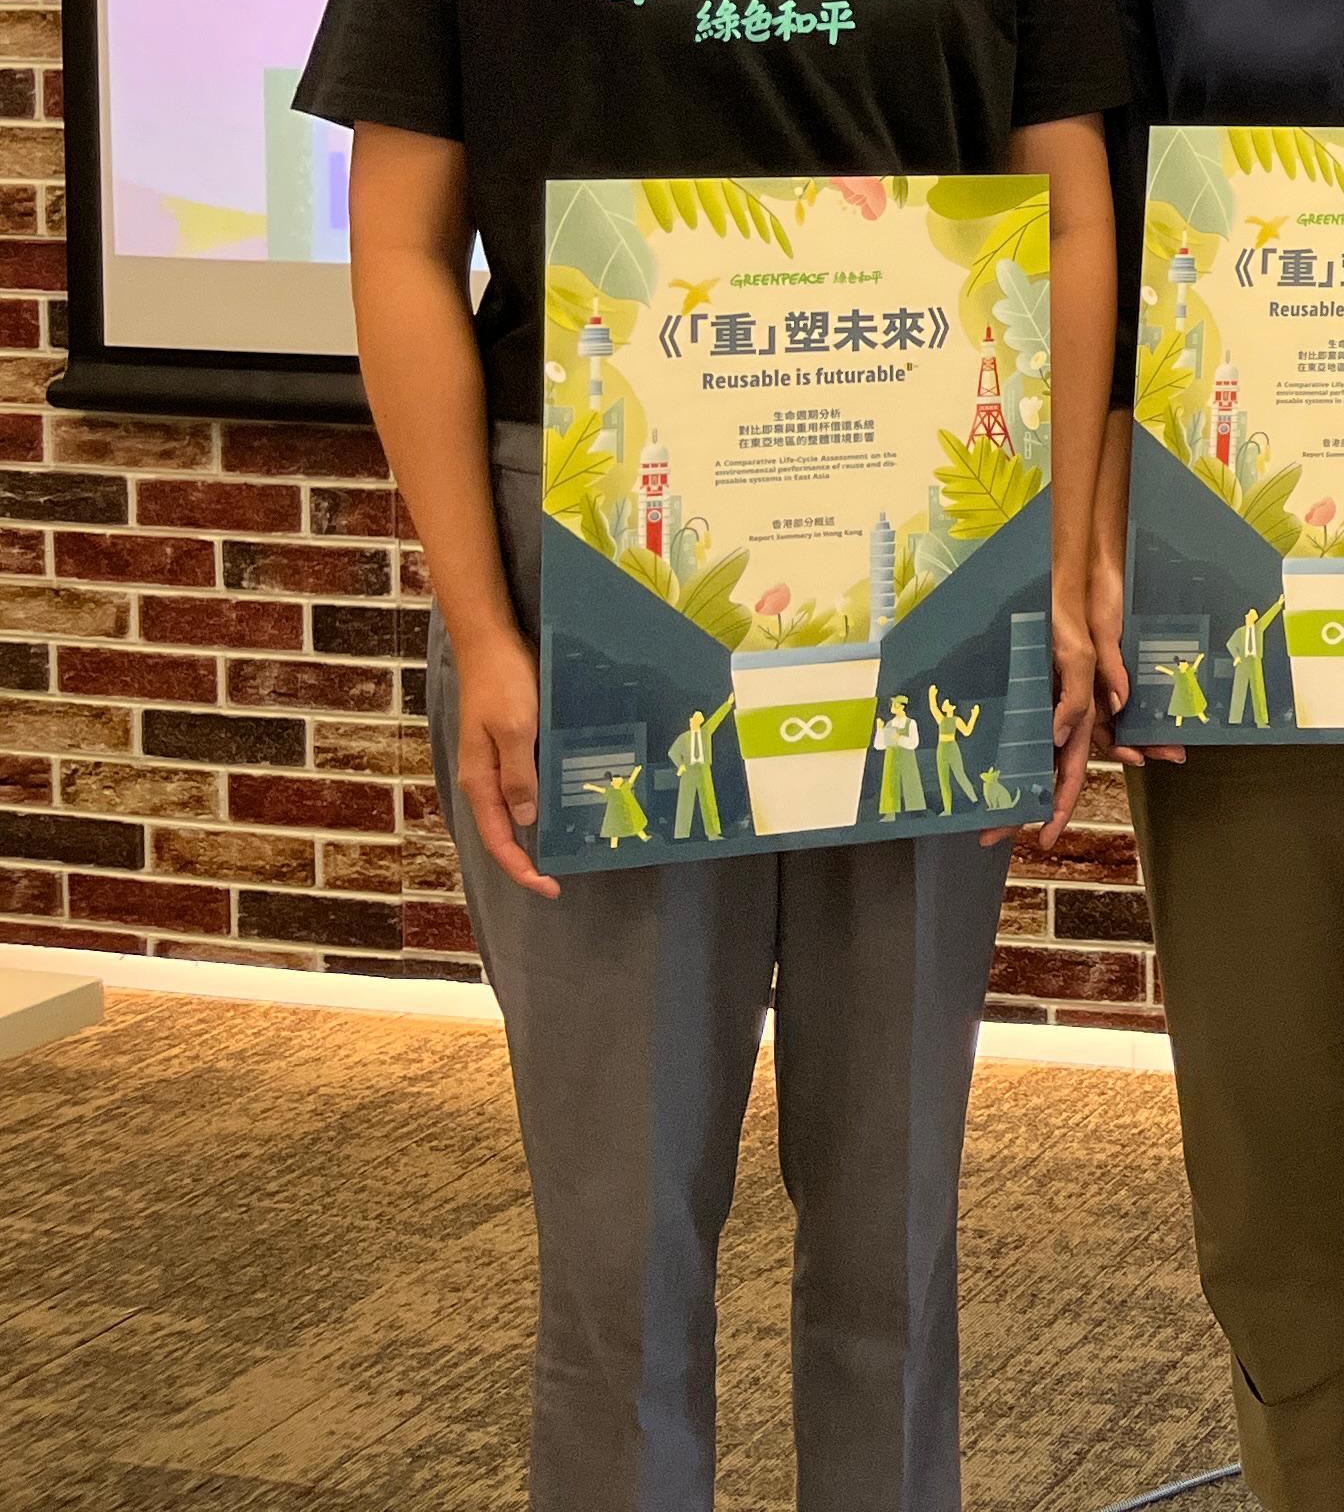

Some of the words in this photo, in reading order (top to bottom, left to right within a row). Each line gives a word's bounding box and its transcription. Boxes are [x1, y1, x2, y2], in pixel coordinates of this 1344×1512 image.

[730, 271, 829, 288] GREENPEACE
[1269, 301, 1344, 318] Reusable
[659, 306, 950, 359] 《「重」塑未來》
[702, 369, 791, 390] Reusable
[796, 368, 811, 386] is
[815, 364, 906, 385] futurable
